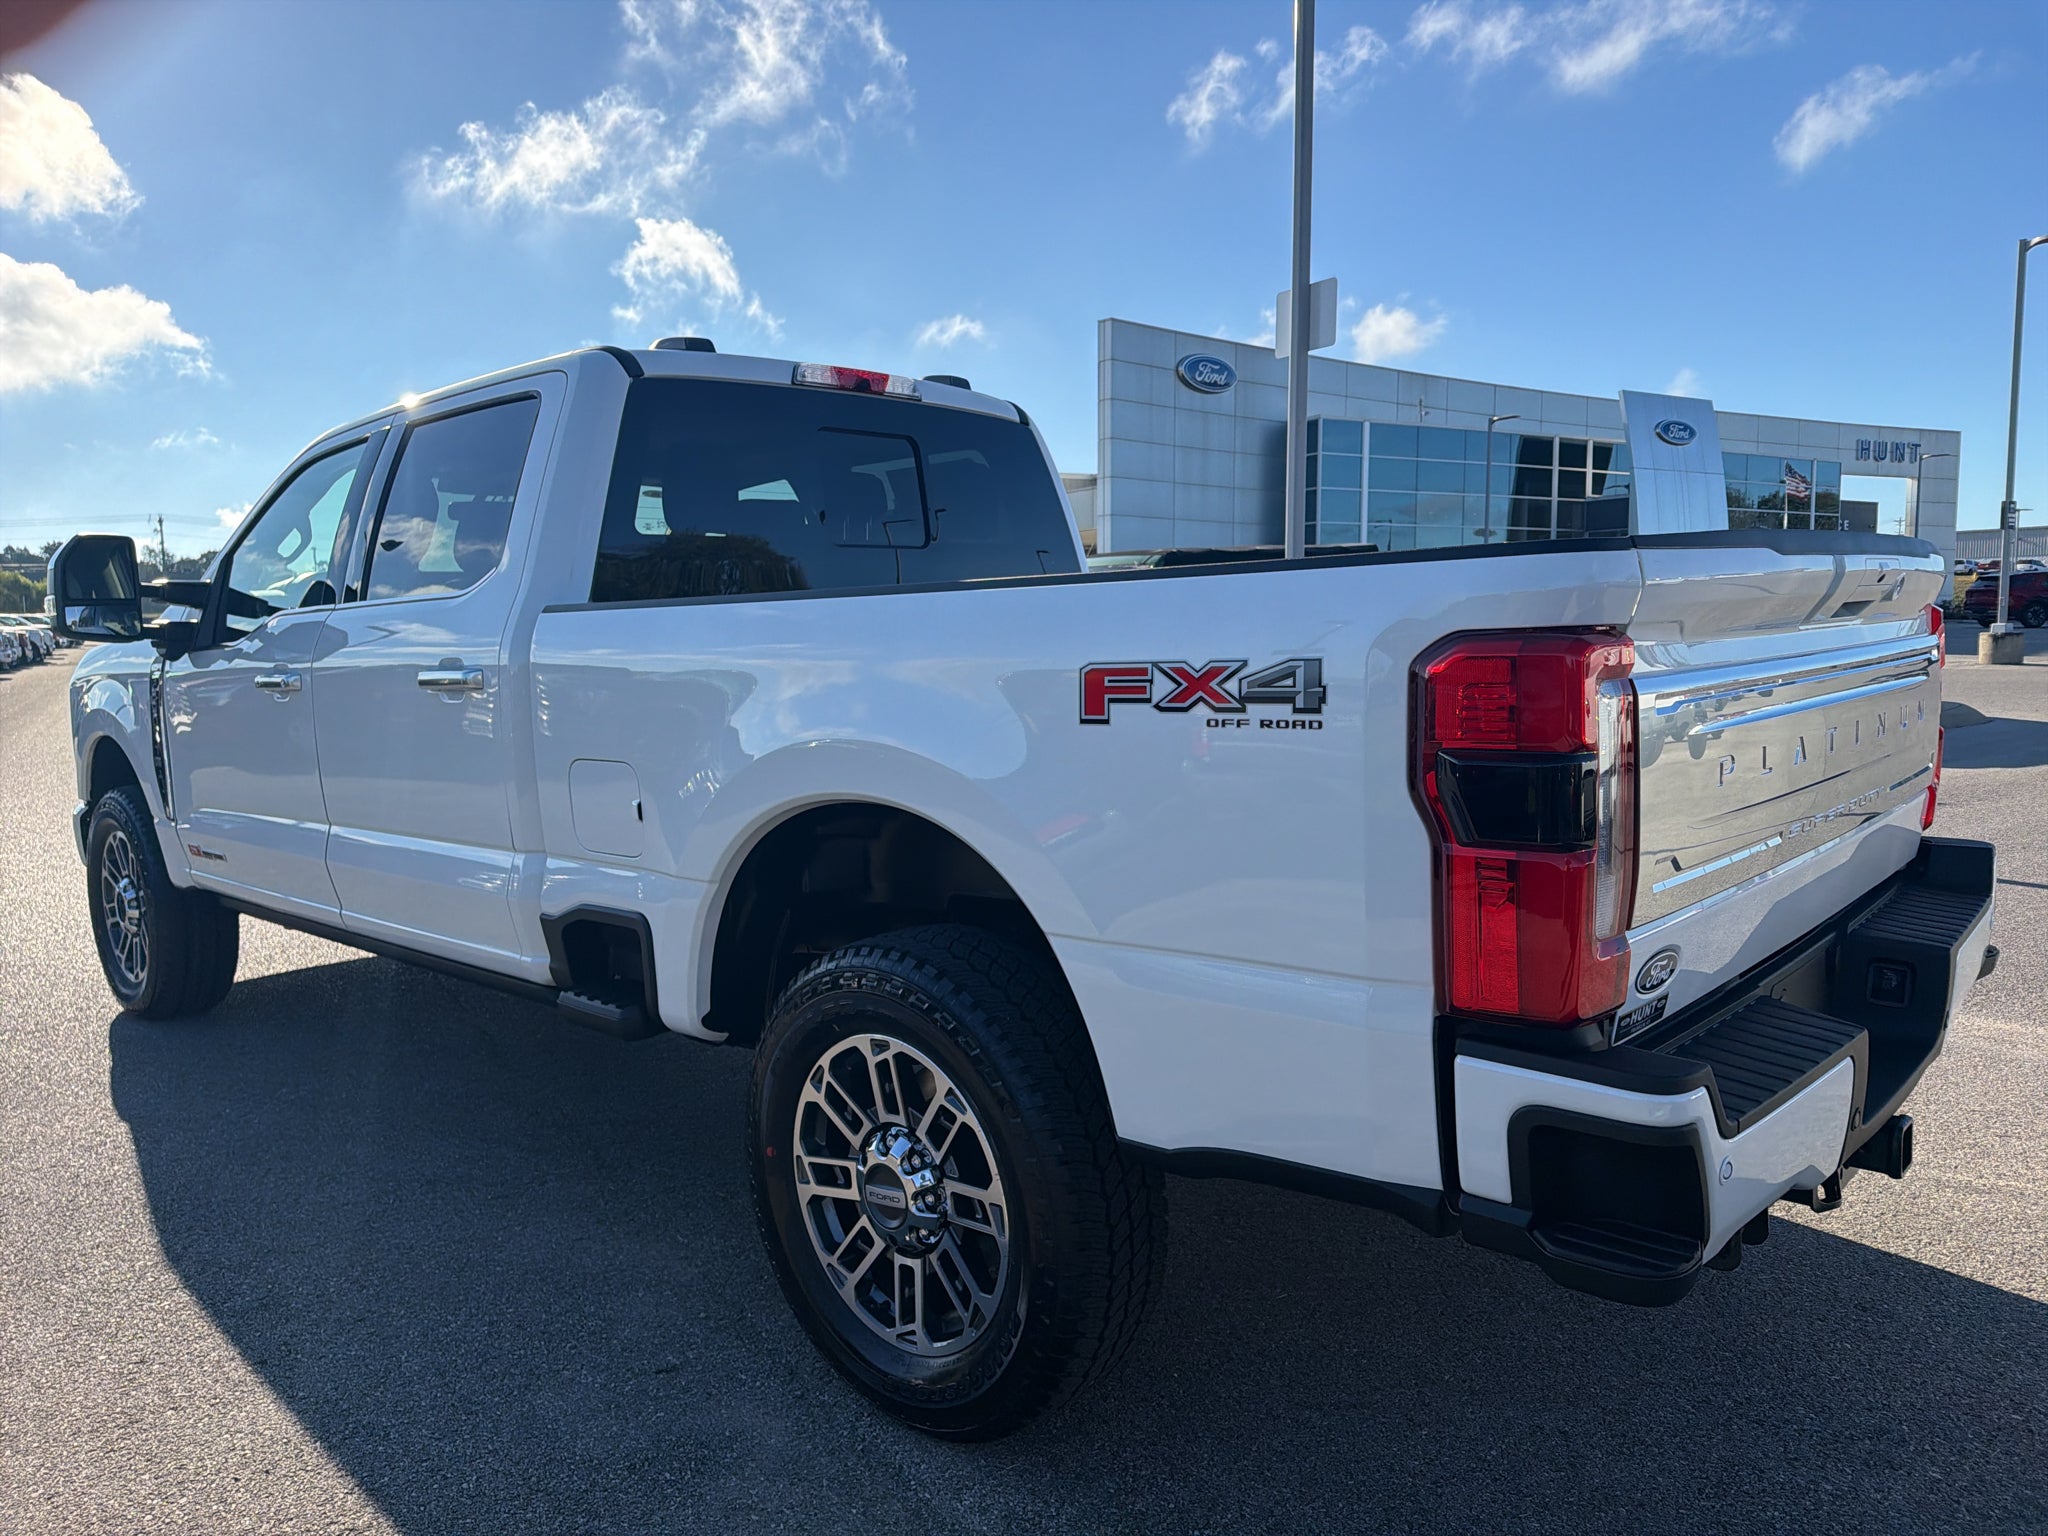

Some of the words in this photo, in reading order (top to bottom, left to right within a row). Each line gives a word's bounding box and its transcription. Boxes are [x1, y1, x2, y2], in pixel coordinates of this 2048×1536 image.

[1195, 361, 1228, 386] Ford
[1668, 423, 1690, 439] Ford
[1857, 439, 1922, 463] HUNT
[1079, 656, 1327, 725] FX4
[1206, 718, 1250, 729] OFF
[1259, 718, 1323, 730] ROAD
[1716, 698, 1926, 788] PLATINUM
[1645, 958, 1674, 989] Ford
[1629, 1000, 1659, 1025] HUNT
[869, 1191, 901, 1204] FORD
